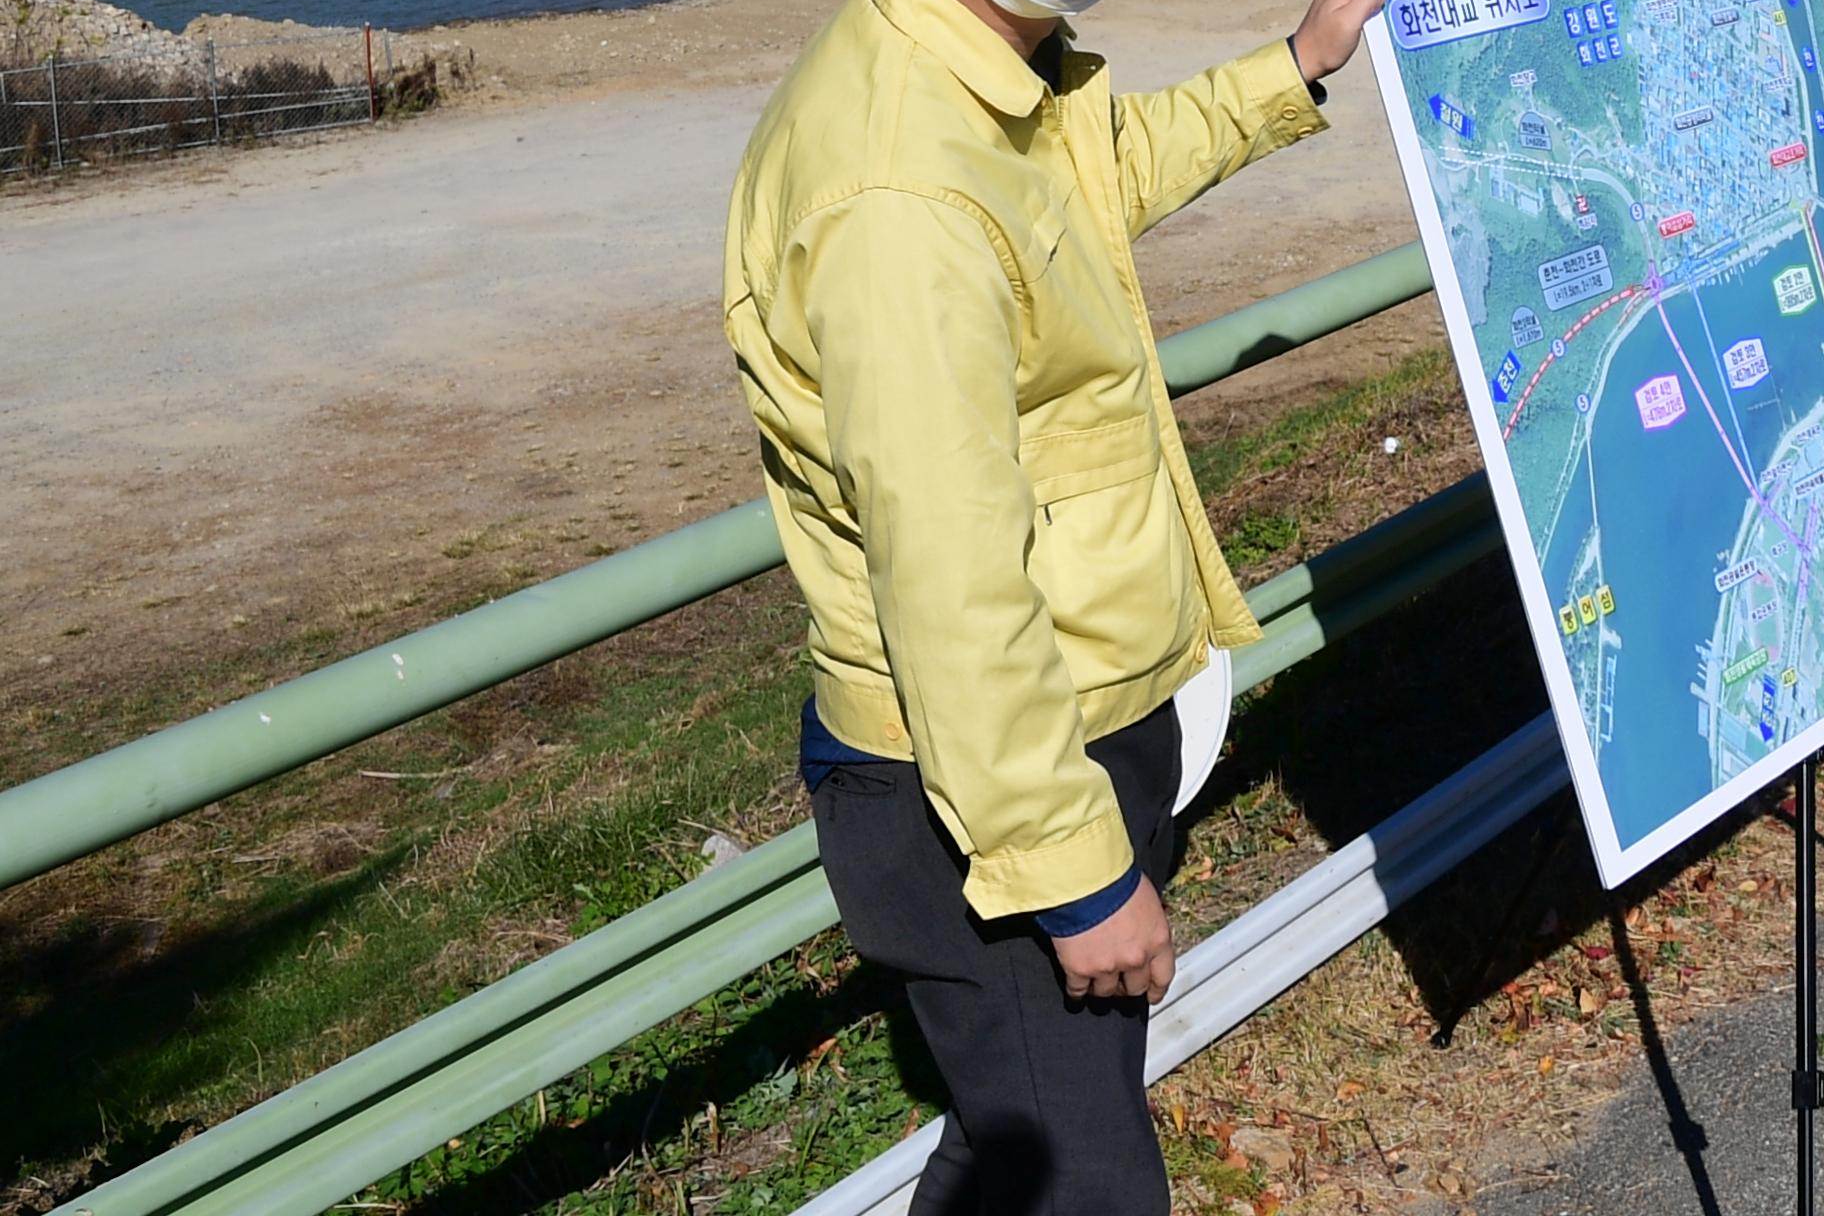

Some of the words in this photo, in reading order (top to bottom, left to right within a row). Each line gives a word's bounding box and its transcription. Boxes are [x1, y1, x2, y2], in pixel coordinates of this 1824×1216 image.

[1566, 3, 1617, 34] 강원도
[1577, 36, 1622, 64] 화천군
[1563, 591, 1613, 631] 붕어섬
